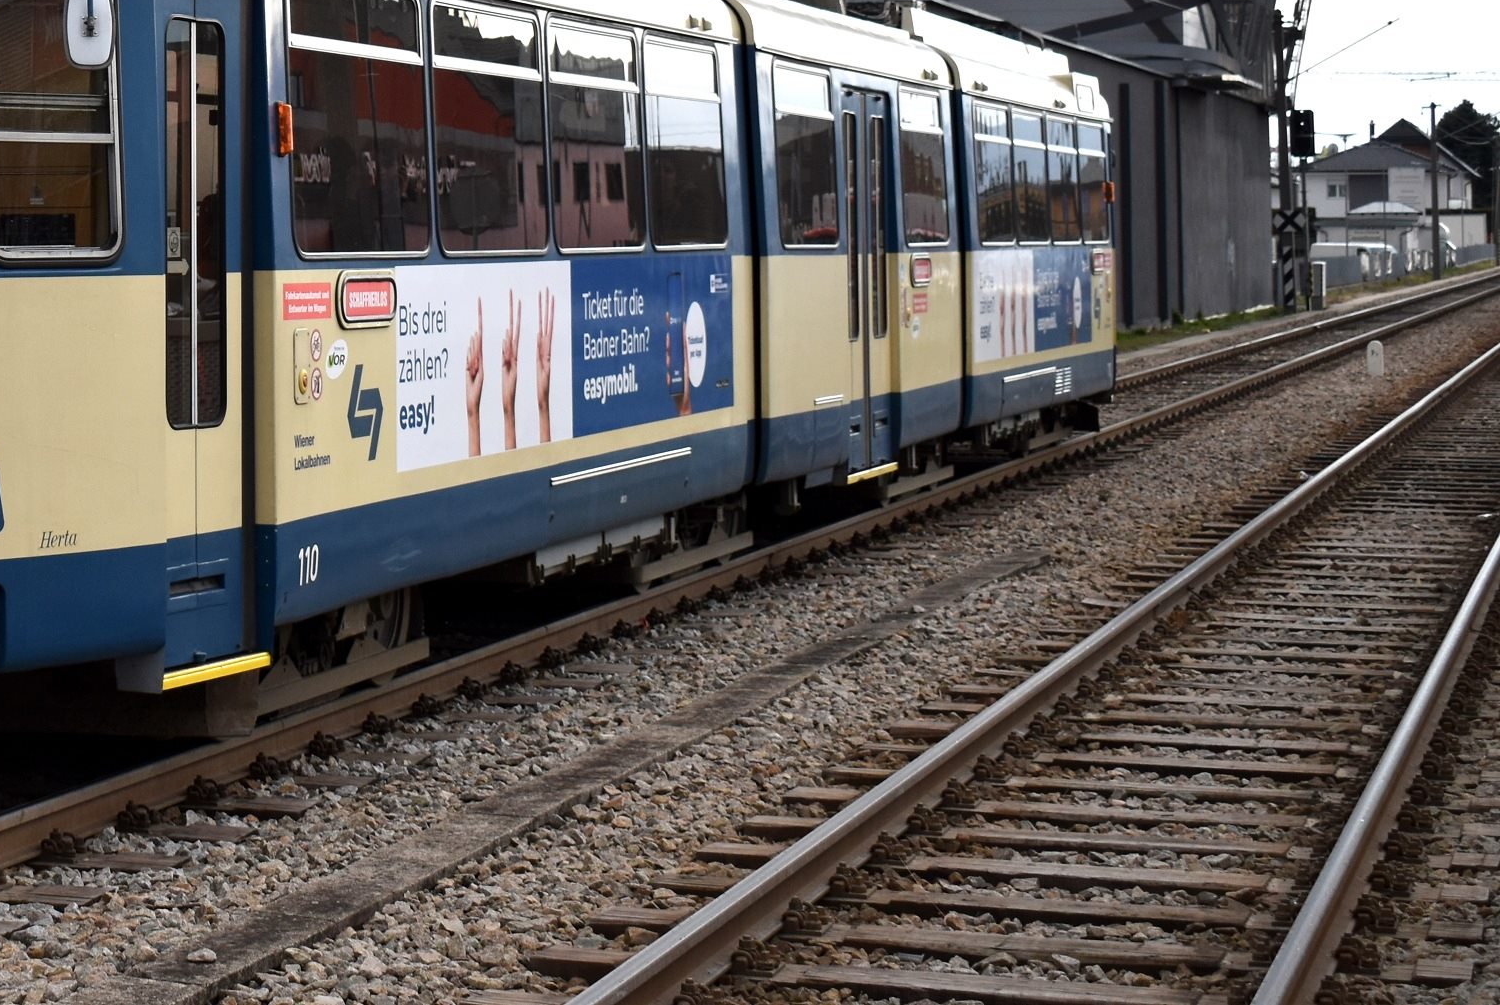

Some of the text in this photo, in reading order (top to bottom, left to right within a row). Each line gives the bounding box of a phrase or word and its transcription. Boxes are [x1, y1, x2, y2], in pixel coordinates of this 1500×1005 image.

[349, 290, 388, 309] SCHAFFNERLOS
[582, 287, 644, 321] Ticket für die
[399, 300, 447, 337] Bis drei
[583, 325, 650, 361] Badner Bahn?
[399, 348, 449, 383] zählen?
[583, 362, 638, 405] easymobil.
[399, 395, 435, 434] easy!
[294, 434, 315, 449] Wiener
[294, 453, 331, 471] Lokalbahnen
[39, 529, 77, 549] Herta
[298, 543, 319, 587] 110
